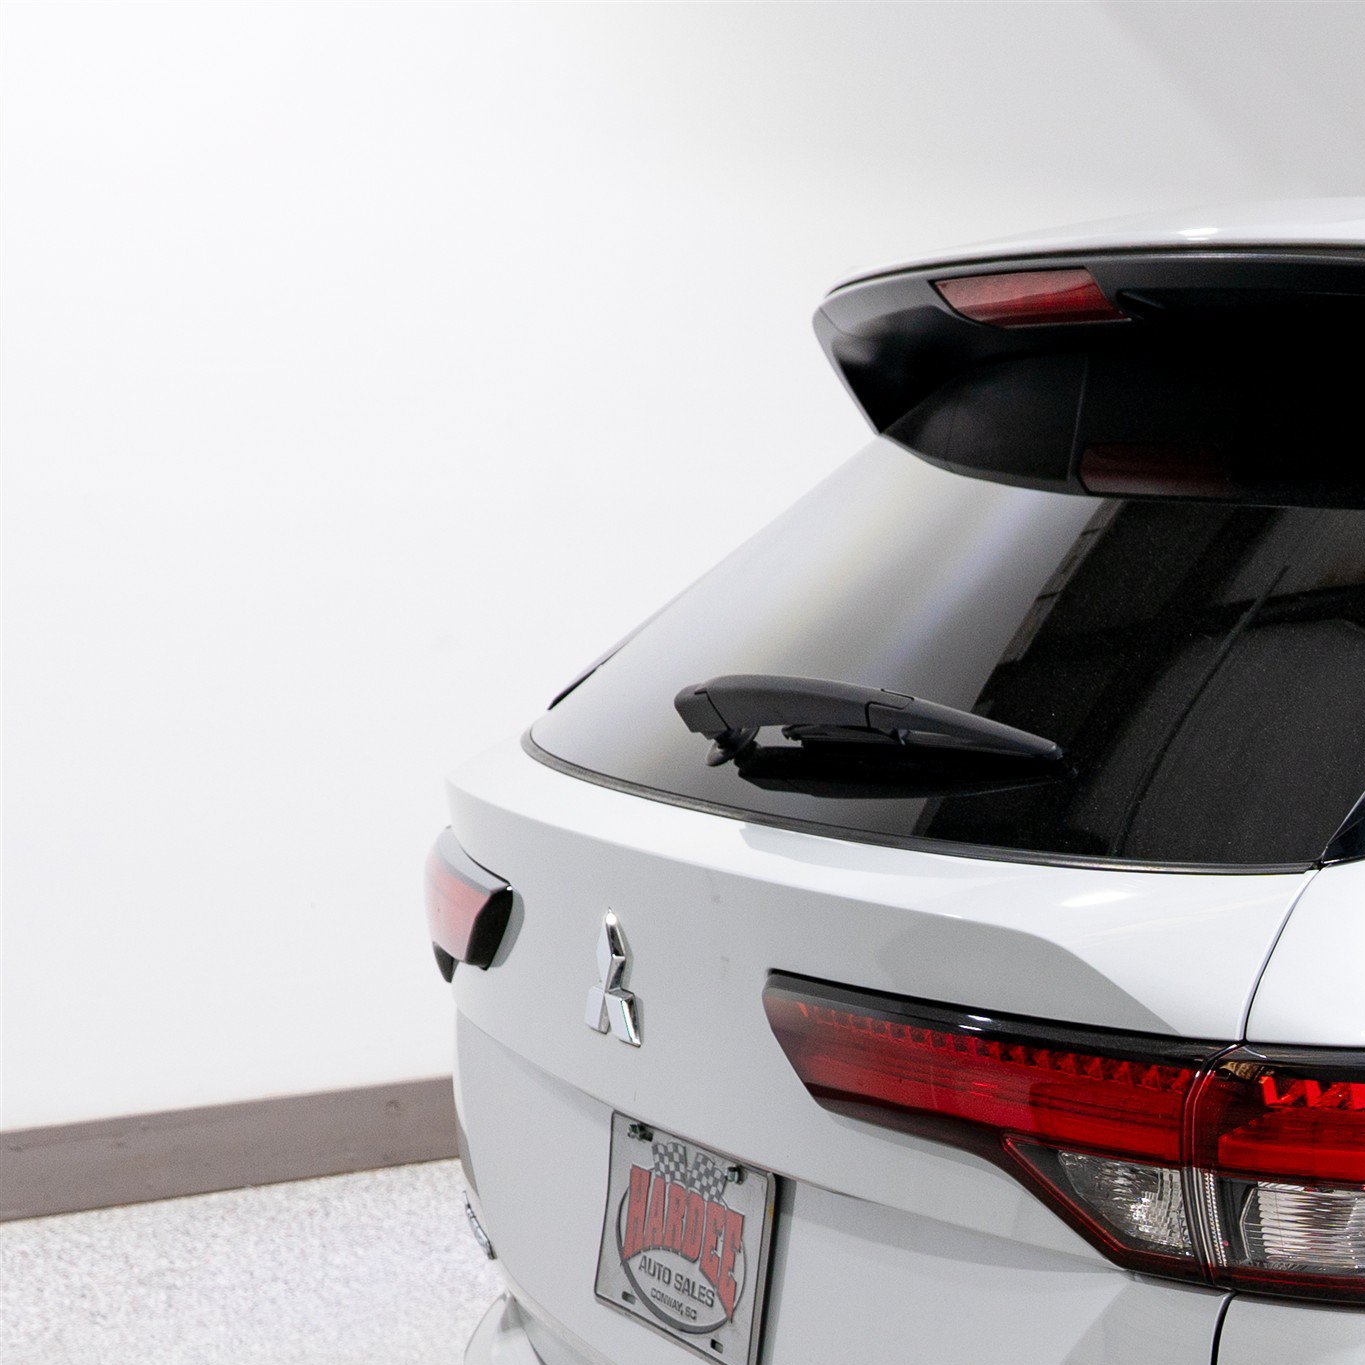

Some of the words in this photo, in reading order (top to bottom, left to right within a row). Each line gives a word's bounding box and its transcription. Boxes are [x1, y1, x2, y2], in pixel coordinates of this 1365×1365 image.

[621, 1163, 745, 1323] HARDEE
[638, 1255, 672, 1286] AUTO
[674, 1273, 716, 1308] SALES
[651, 1287, 685, 1316] CONWAY,
[682, 1308, 697, 1321] SC
